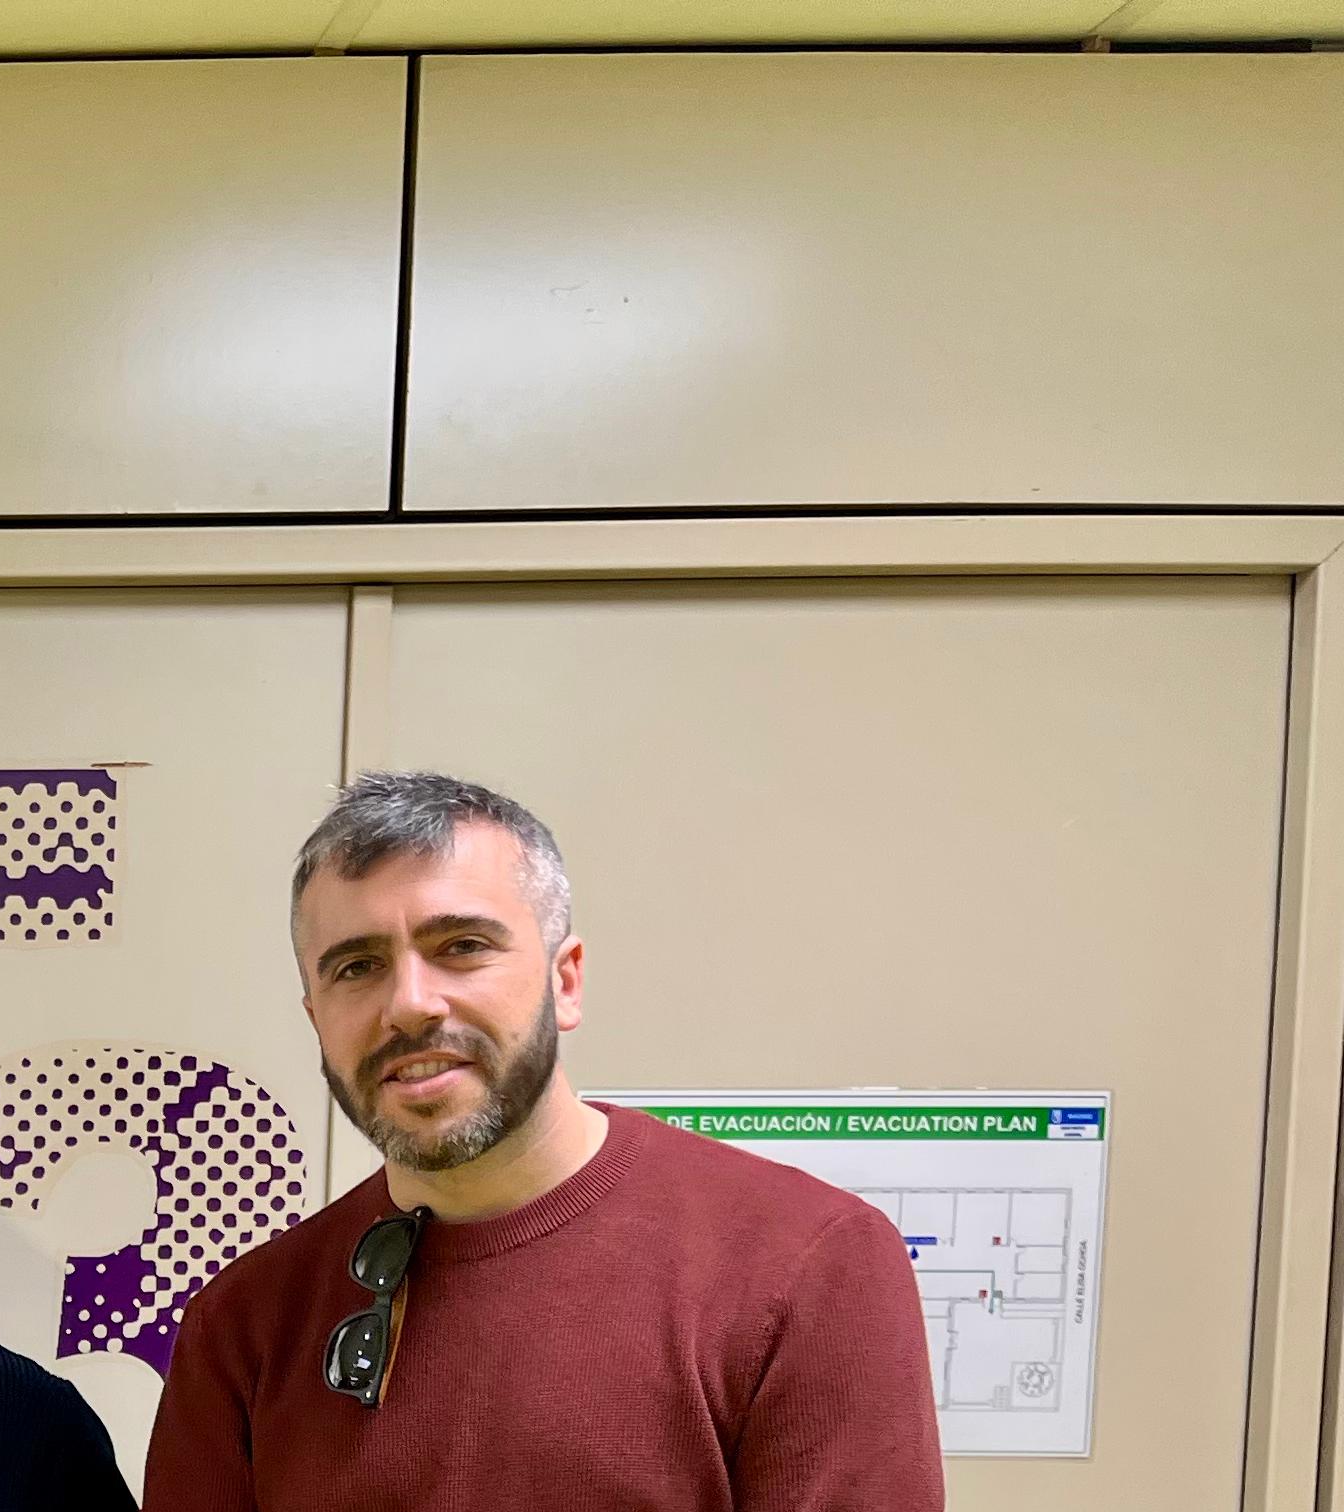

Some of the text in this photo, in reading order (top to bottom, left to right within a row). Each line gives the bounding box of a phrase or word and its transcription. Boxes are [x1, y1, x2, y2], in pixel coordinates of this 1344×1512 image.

[699, 1111, 831, 1132] EVACUACIÓN
[835, 1115, 841, 1132] /
[848, 1116, 978, 1132] EVACUATION
[984, 1116, 1037, 1133] PLAN
